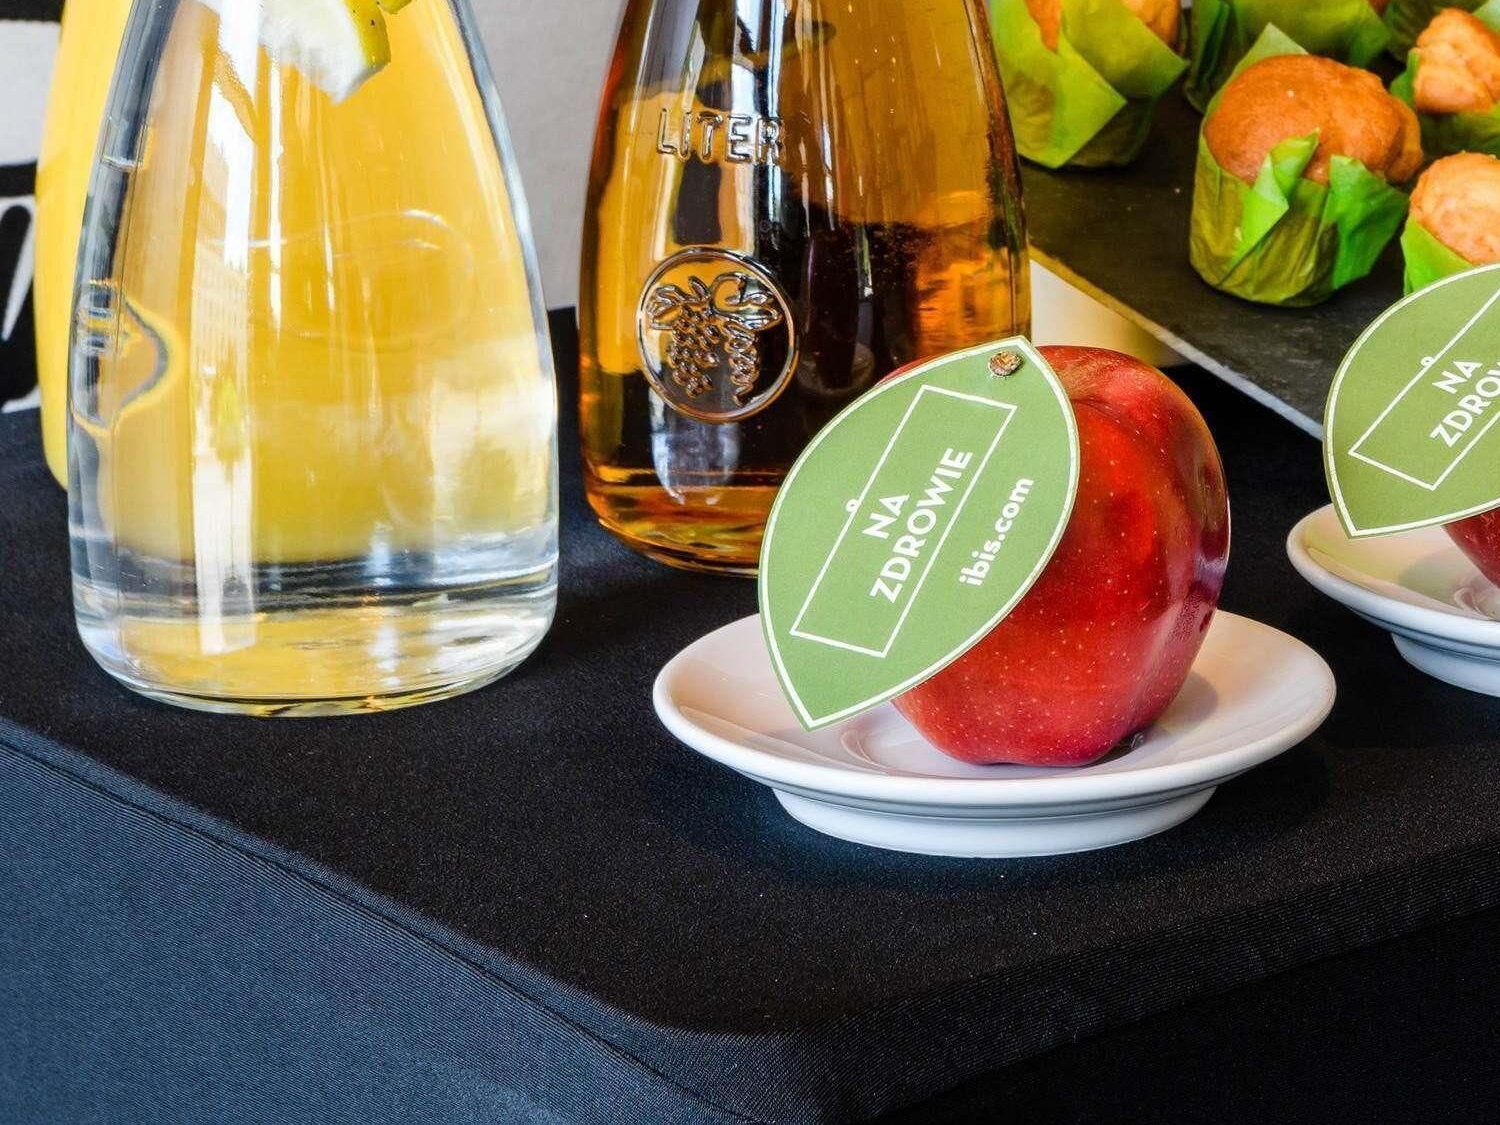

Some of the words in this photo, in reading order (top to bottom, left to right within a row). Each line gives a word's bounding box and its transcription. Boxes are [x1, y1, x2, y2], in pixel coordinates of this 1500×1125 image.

[656, 108, 783, 163] LITER
[1432, 359, 1483, 394] NA
[861, 492, 911, 539] NA
[869, 448, 973, 604] ZDROWIE
[958, 477, 1035, 587] ibis.com
